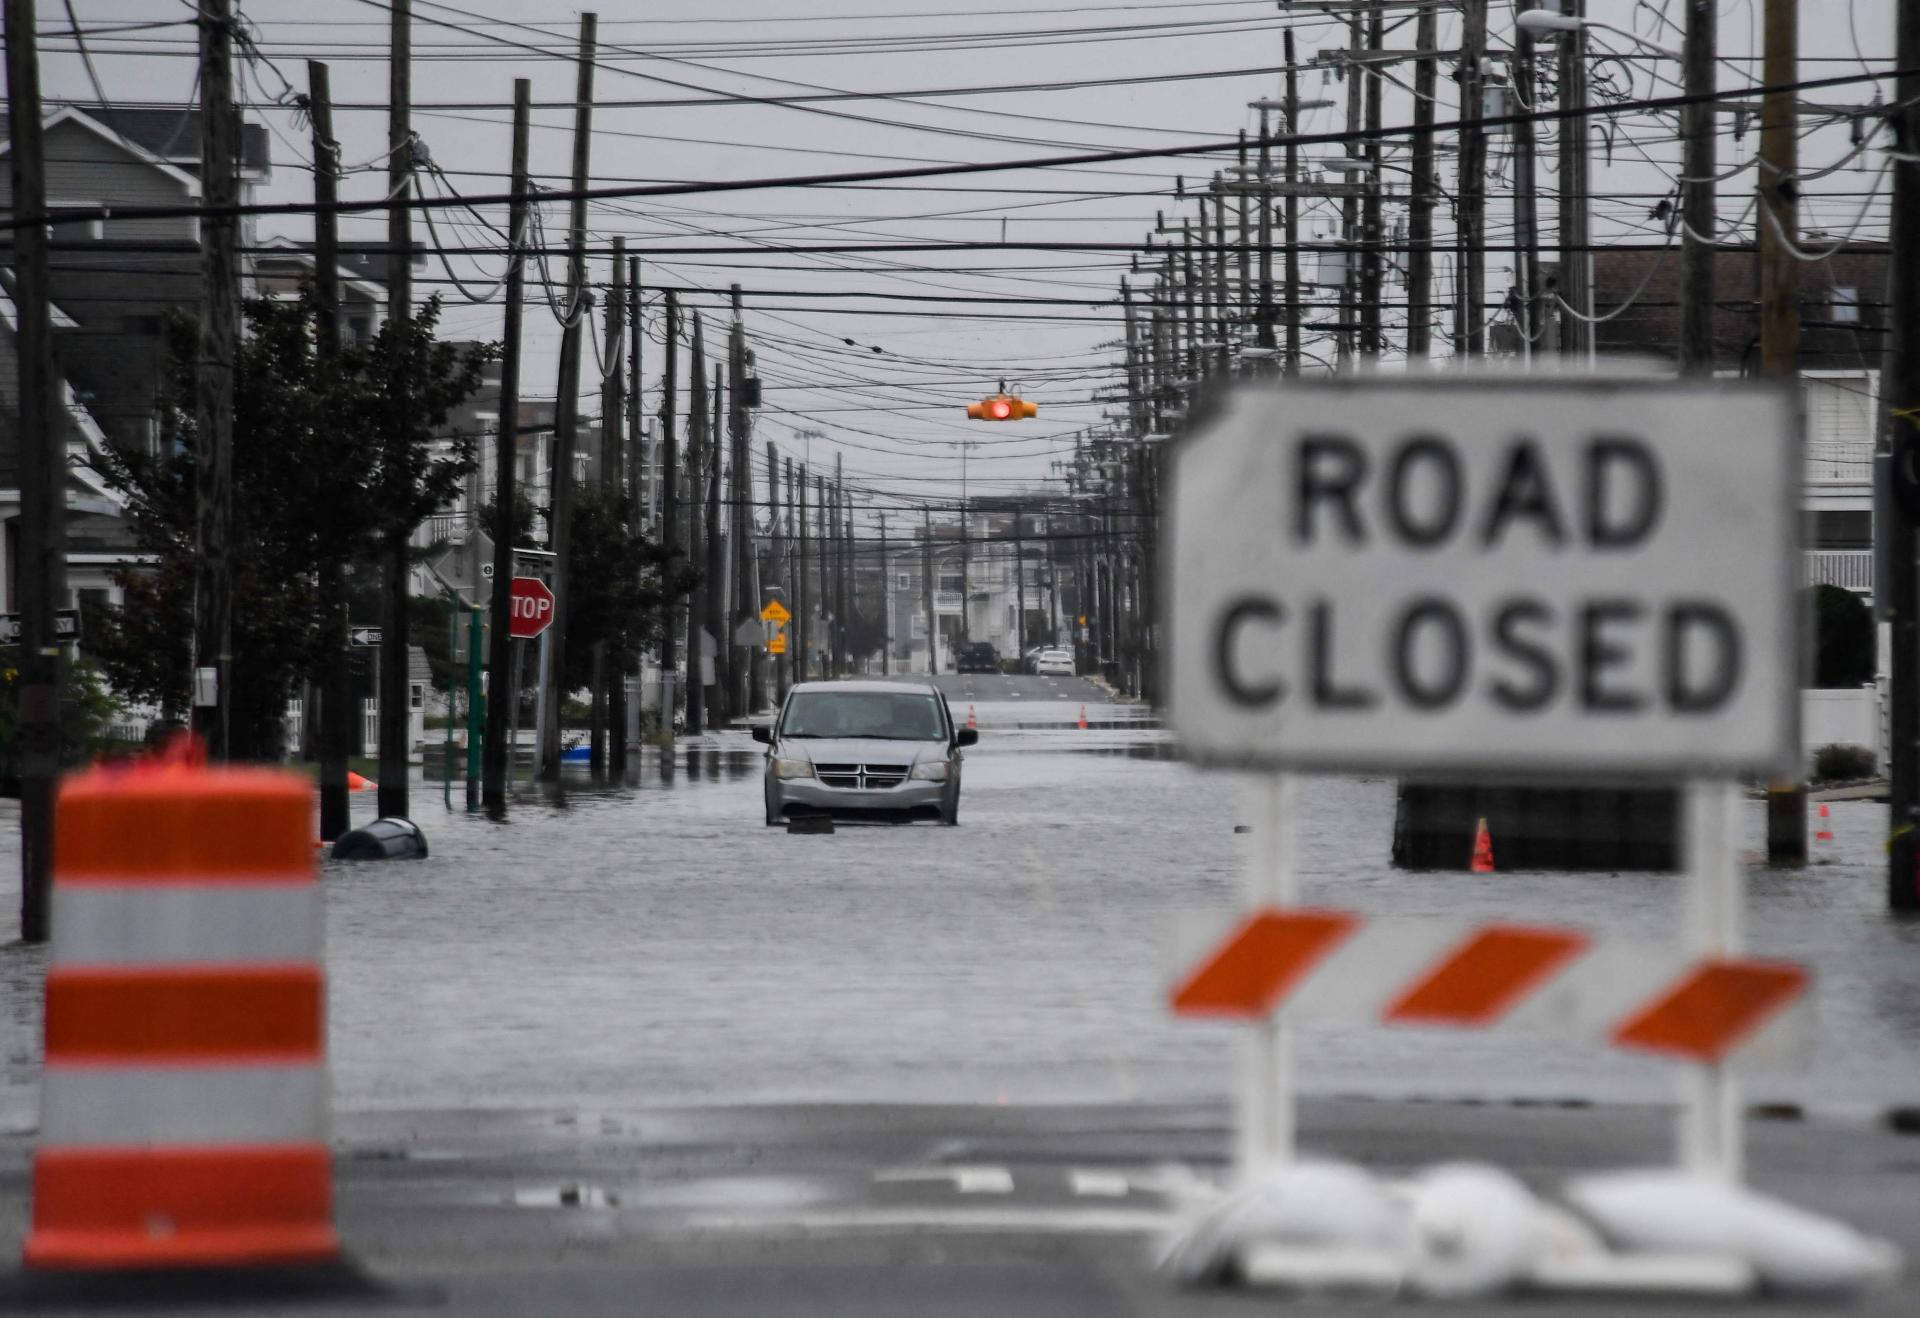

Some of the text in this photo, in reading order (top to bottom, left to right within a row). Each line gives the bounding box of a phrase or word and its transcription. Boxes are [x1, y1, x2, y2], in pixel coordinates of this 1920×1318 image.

[1290, 431, 1667, 550] ROAD
[511, 595, 550, 620] TOP
[1210, 596, 1745, 714] CLOSED
